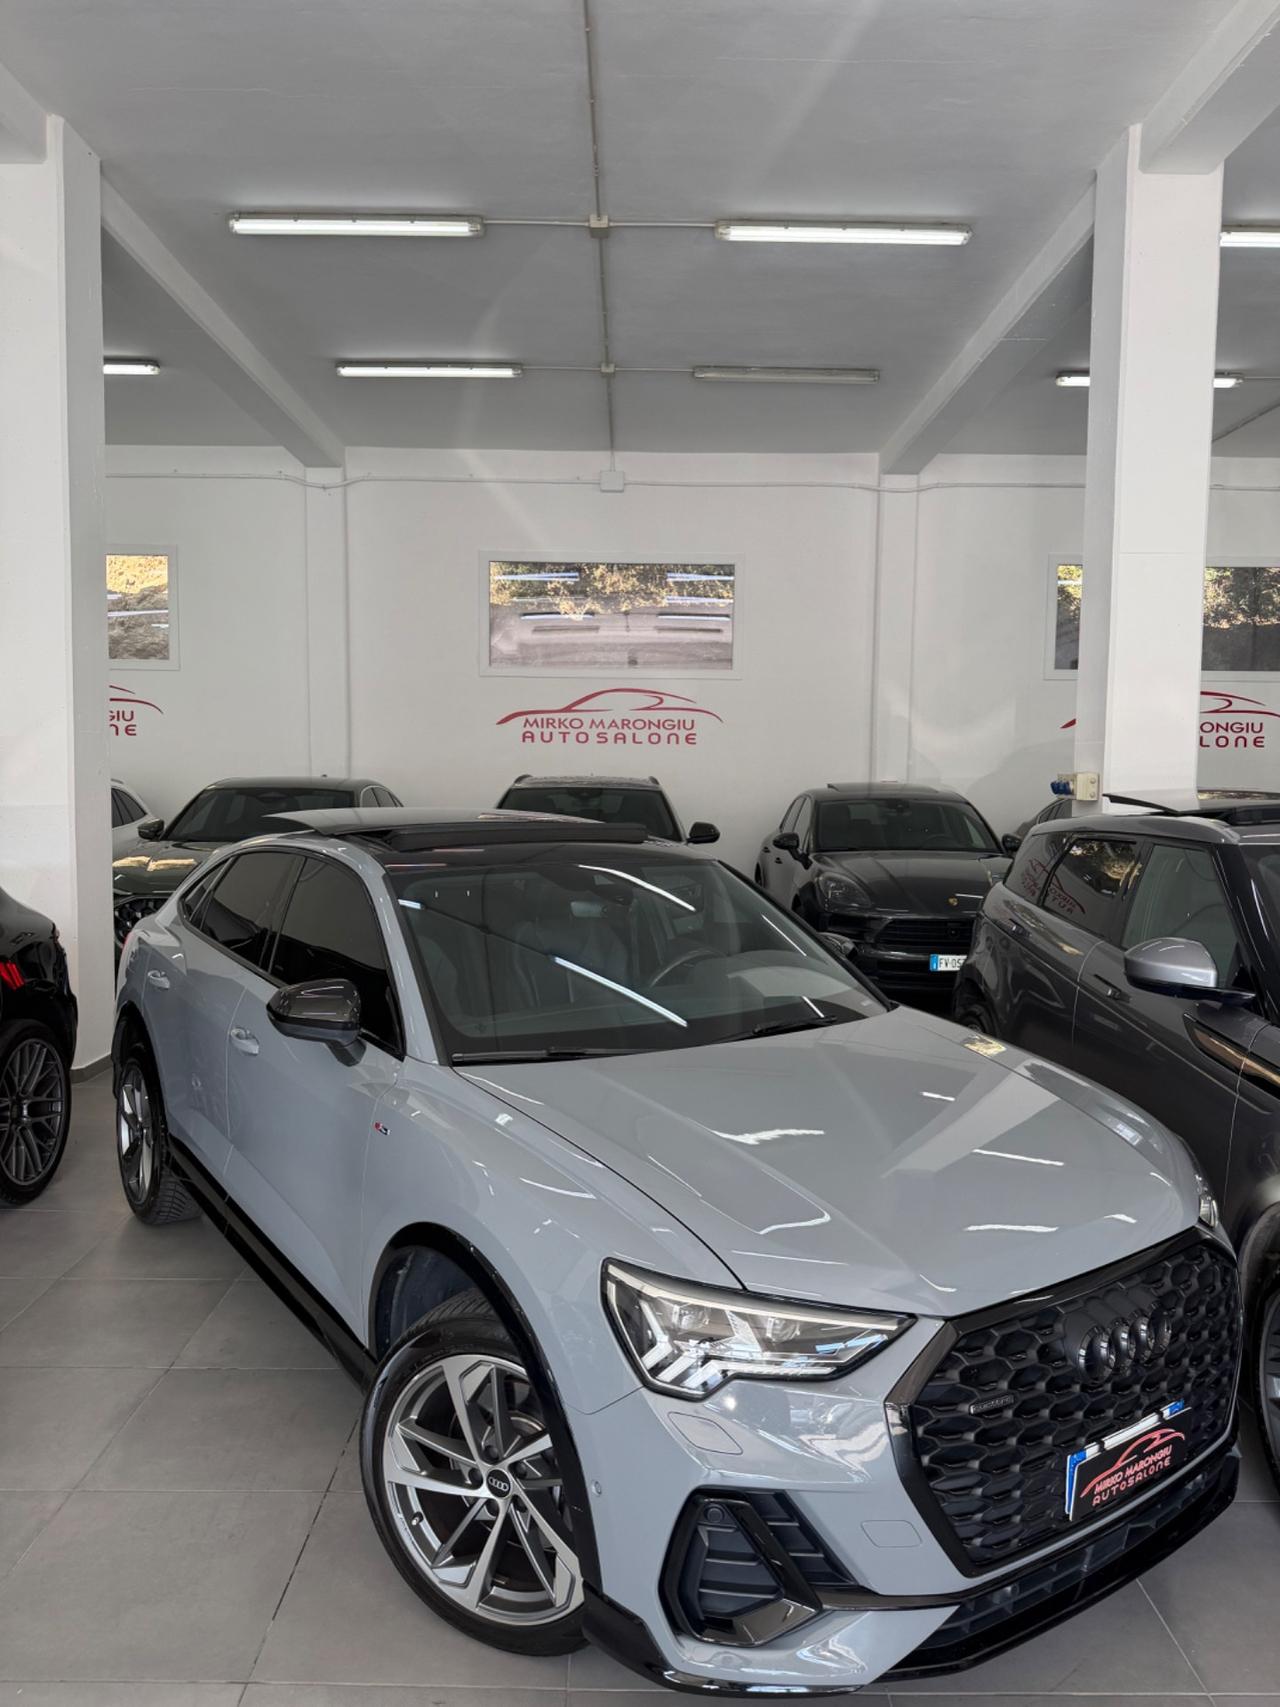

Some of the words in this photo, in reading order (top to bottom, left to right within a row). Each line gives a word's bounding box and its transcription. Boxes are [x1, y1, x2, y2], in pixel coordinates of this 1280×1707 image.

[521, 730, 697, 745] AUTOSALONE
[523, 718, 584, 730] MIRKO
[589, 718, 695, 731] MARONGIU
[1091, 1456, 1171, 1507] AUTOSALONE
[1094, 1471, 1122, 1494] MIRKO
[1125, 1444, 1173, 1478] MARONGIU
